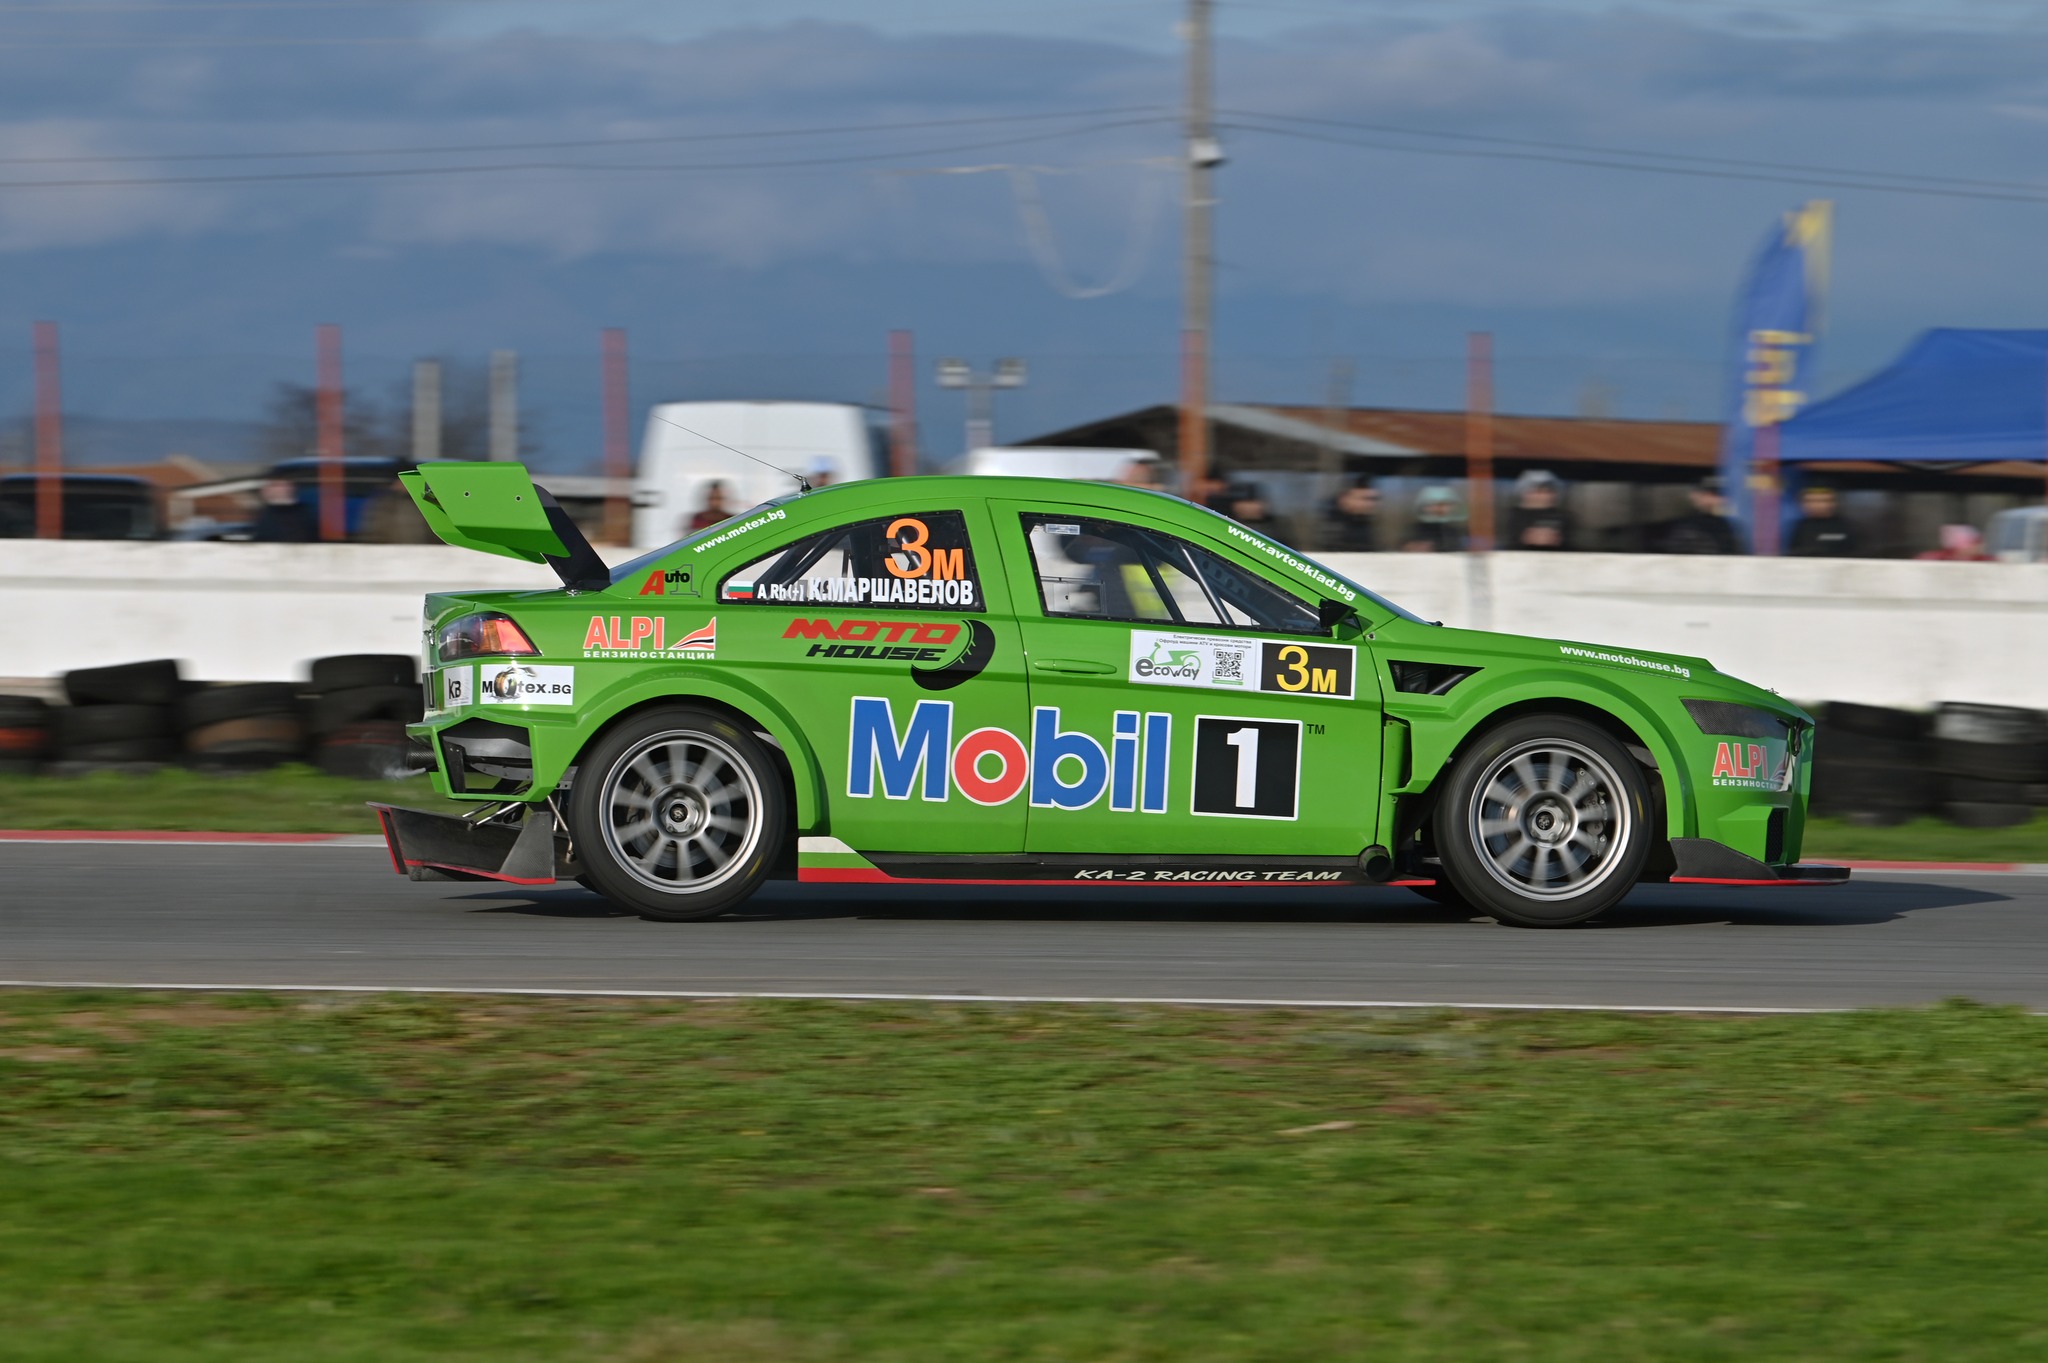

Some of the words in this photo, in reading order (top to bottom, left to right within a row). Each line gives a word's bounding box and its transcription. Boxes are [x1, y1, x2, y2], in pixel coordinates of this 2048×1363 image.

[693, 509, 786, 553] www.motex.bg
[1227, 525, 1356, 601] www.avtosklad.bg
[639, 569, 691, 596] Auto
[583, 616, 664, 650] ALPI
[782, 618, 961, 644] MOTO
[583, 651, 715, 660] БЕНЗИНОСТАНЦИИ
[806, 644, 947, 661] HOUSE
[1560, 646, 1690, 677] www.motohouse.bg
[847, 696, 1172, 814] Mobil
[1227, 727, 1259, 808] 1
[1712, 743, 1768, 780] ALPI
[1074, 870, 1147, 881] KA-2
[1153, 870, 1257, 881] RACING
[1261, 870, 1342, 881] TEAM
